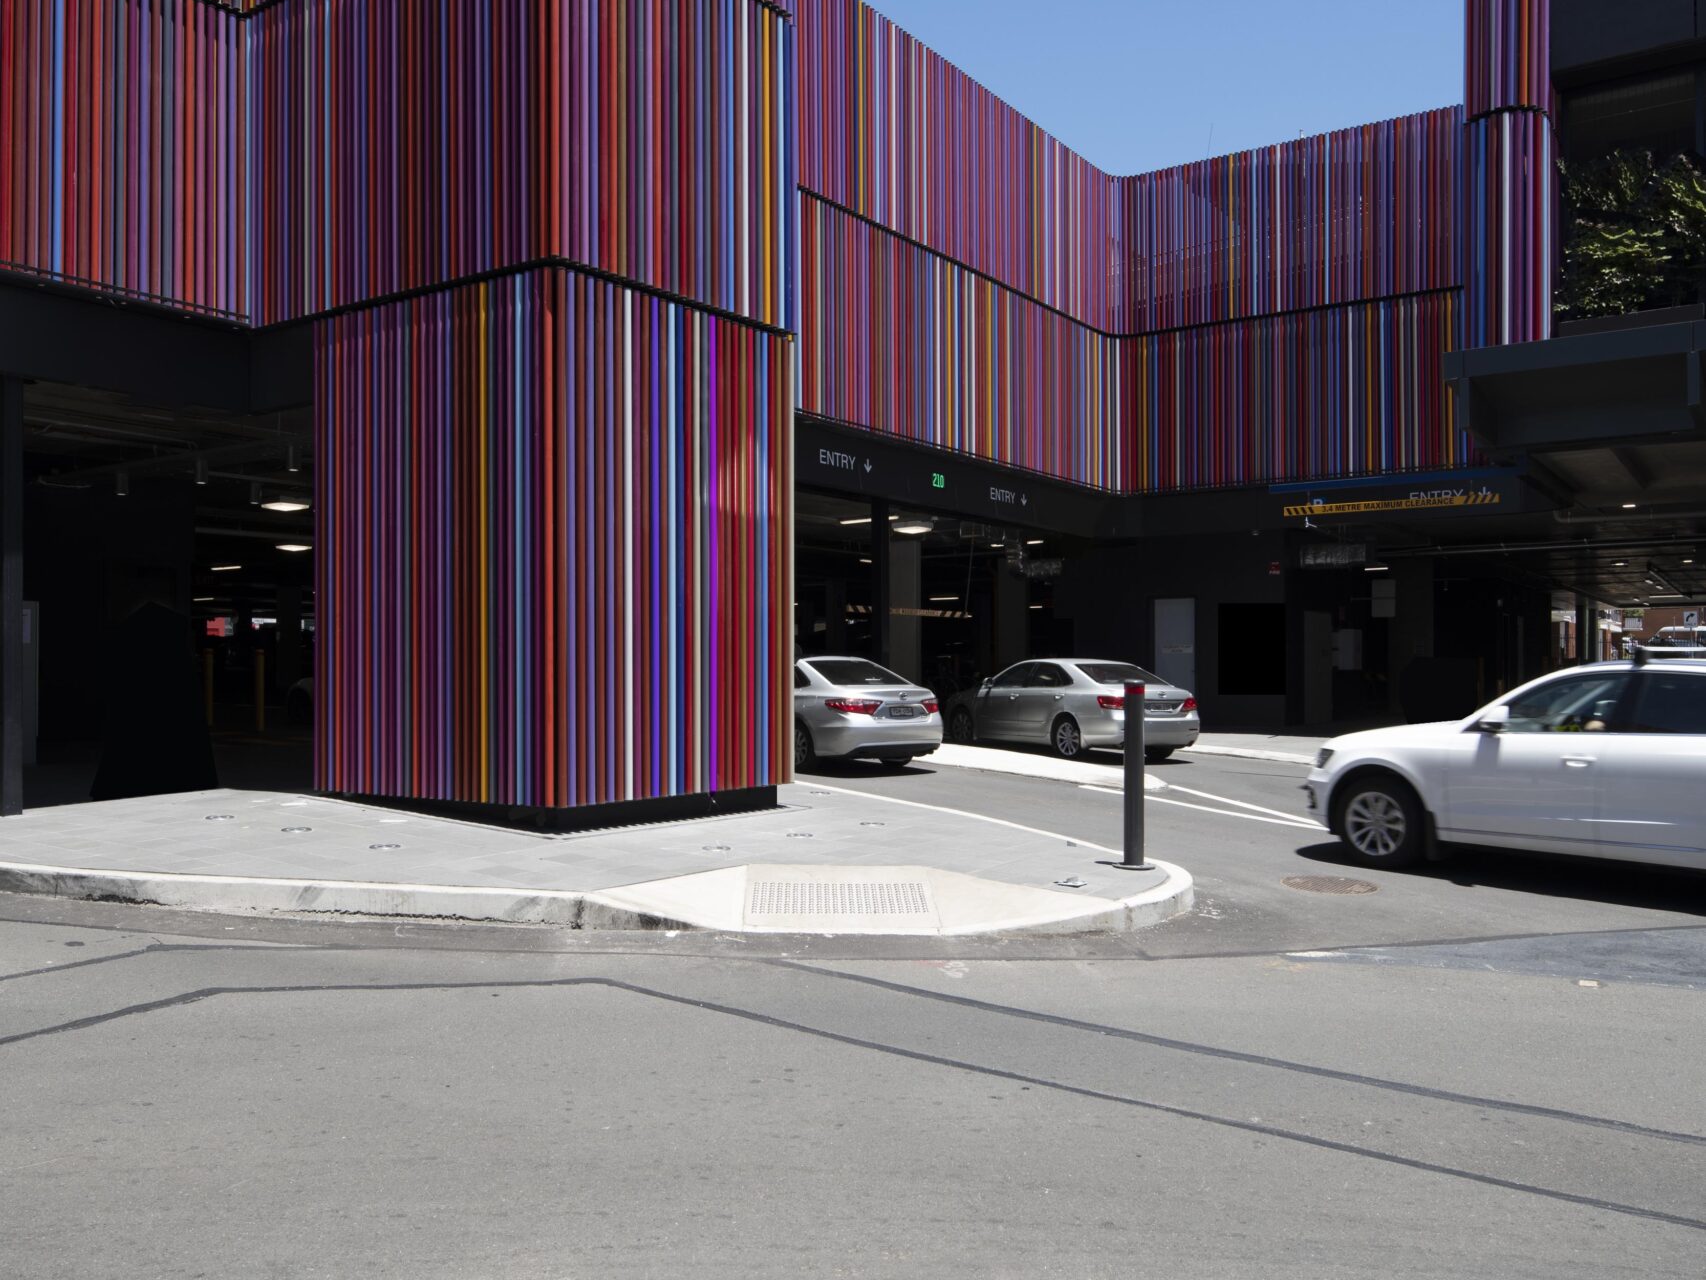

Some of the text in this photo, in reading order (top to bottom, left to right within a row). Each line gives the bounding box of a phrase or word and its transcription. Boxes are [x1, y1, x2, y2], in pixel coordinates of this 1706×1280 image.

[819, 448, 856, 471] ENTRY
[932, 473, 945, 488] 210
[989, 487, 1015, 505] ENTRY
[1335, 503, 1361, 512] METRE
[1363, 500, 1403, 510] MAXIMUM
[1405, 497, 1454, 507] CLEARANCE
